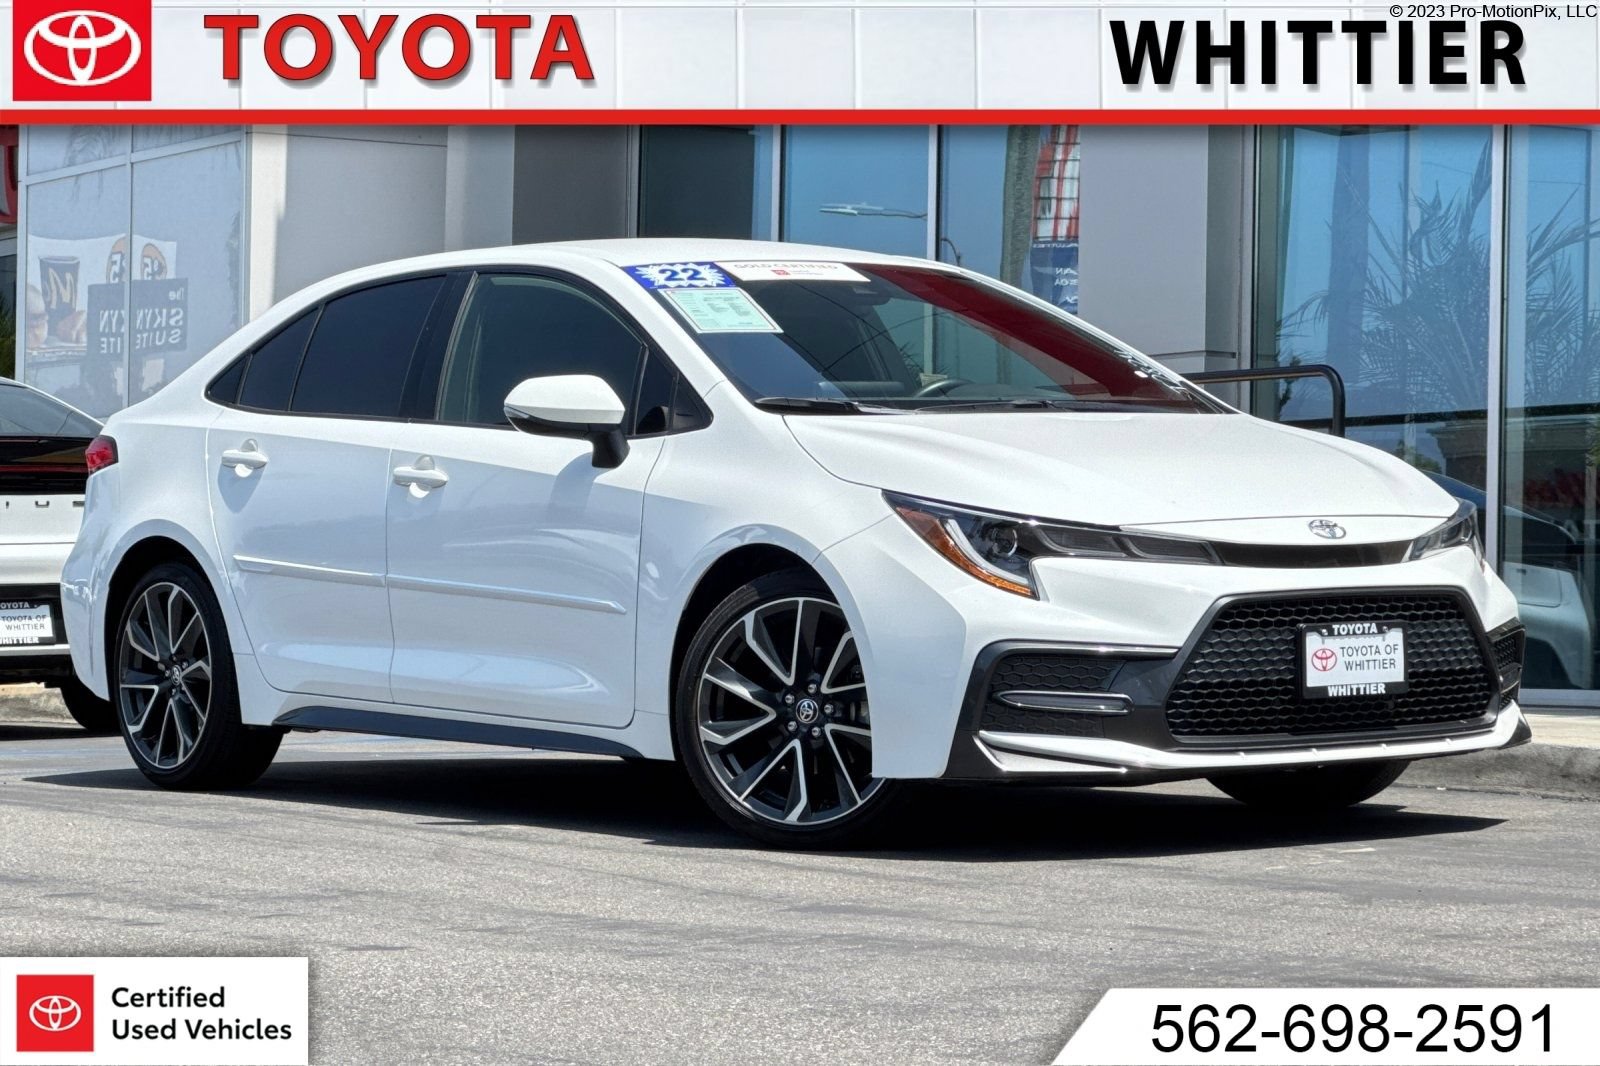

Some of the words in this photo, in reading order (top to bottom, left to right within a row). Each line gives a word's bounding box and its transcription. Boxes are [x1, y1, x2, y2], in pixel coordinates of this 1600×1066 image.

[658, 268, 707, 282] 22
[1332, 623, 1378, 635] TOYOTA
[1340, 645, 1381, 657] TOYOTA
[1384, 644, 1399, 655] OF
[1344, 658, 1396, 671] WHITTIER
[1327, 683, 1386, 696] WHITTIER
